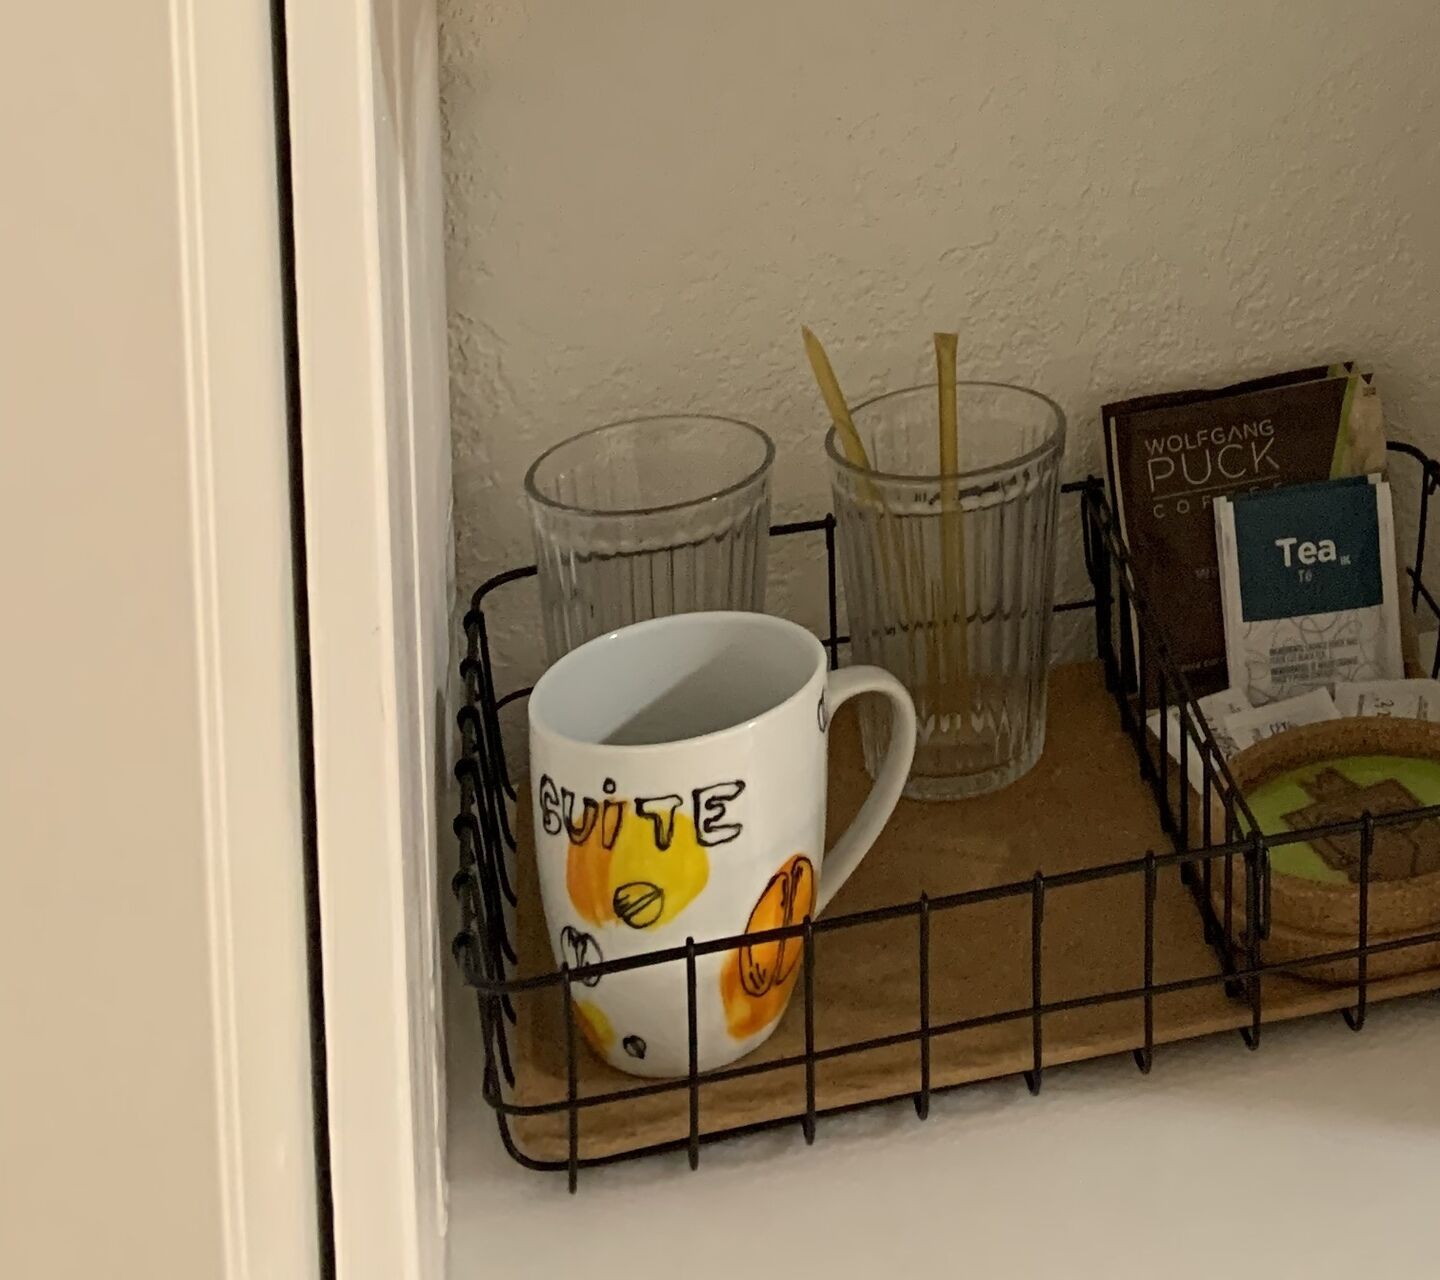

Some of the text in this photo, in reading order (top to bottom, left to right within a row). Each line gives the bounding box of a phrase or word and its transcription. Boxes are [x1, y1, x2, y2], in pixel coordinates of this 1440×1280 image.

[1144, 419, 1275, 455] WOLFGANG
[1147, 436, 1281, 492] PUCK
[1275, 537, 1337, 568] Tea
